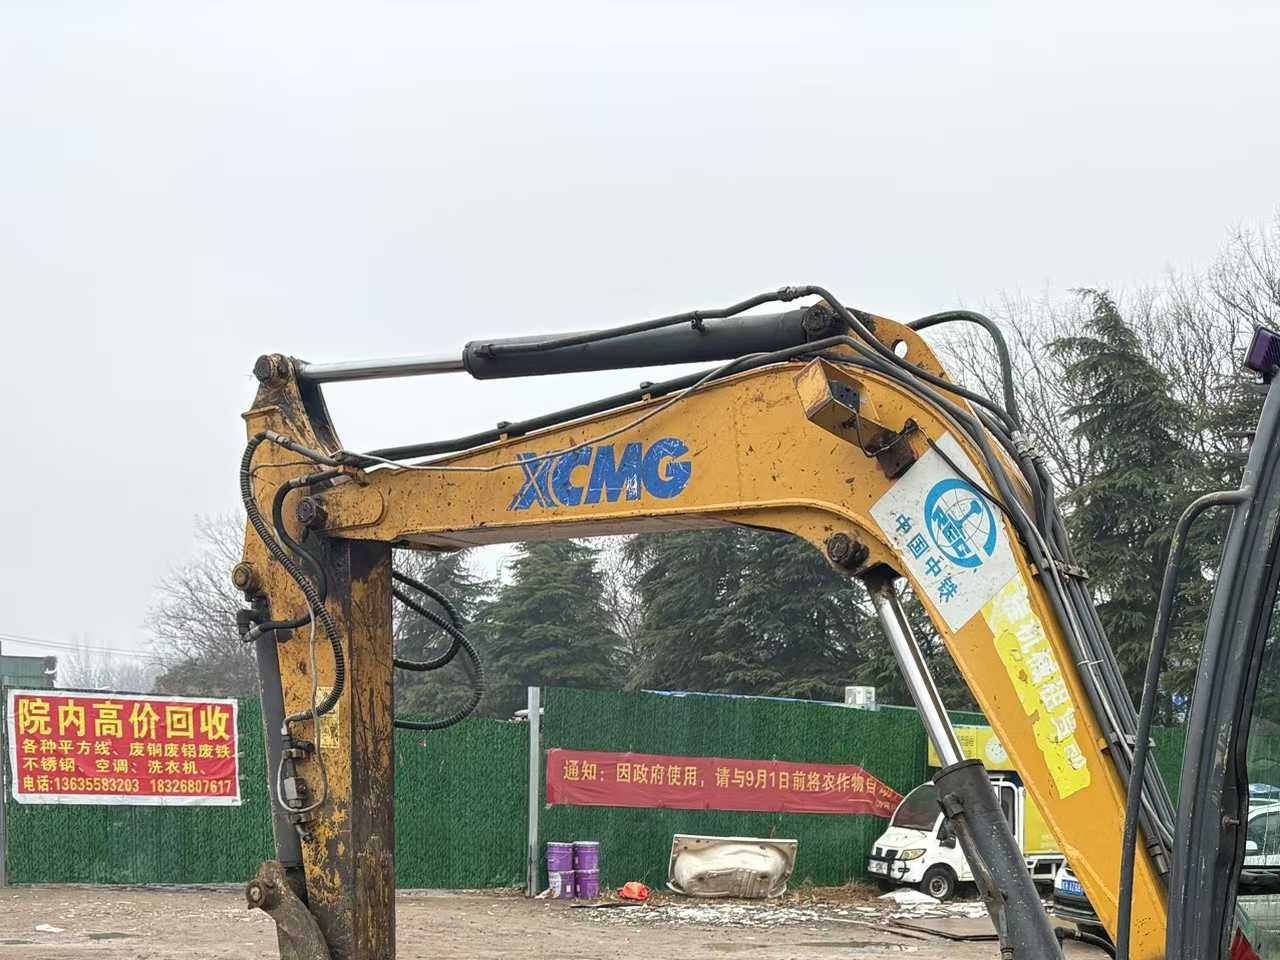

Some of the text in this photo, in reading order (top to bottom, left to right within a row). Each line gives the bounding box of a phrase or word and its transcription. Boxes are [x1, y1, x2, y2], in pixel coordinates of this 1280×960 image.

[506, 438, 691, 511] XCMG
[895, 514, 958, 603] 中国中铁
[18, 698, 231, 741] 院内高价回收
[150, 779, 232, 793] 18326807617
